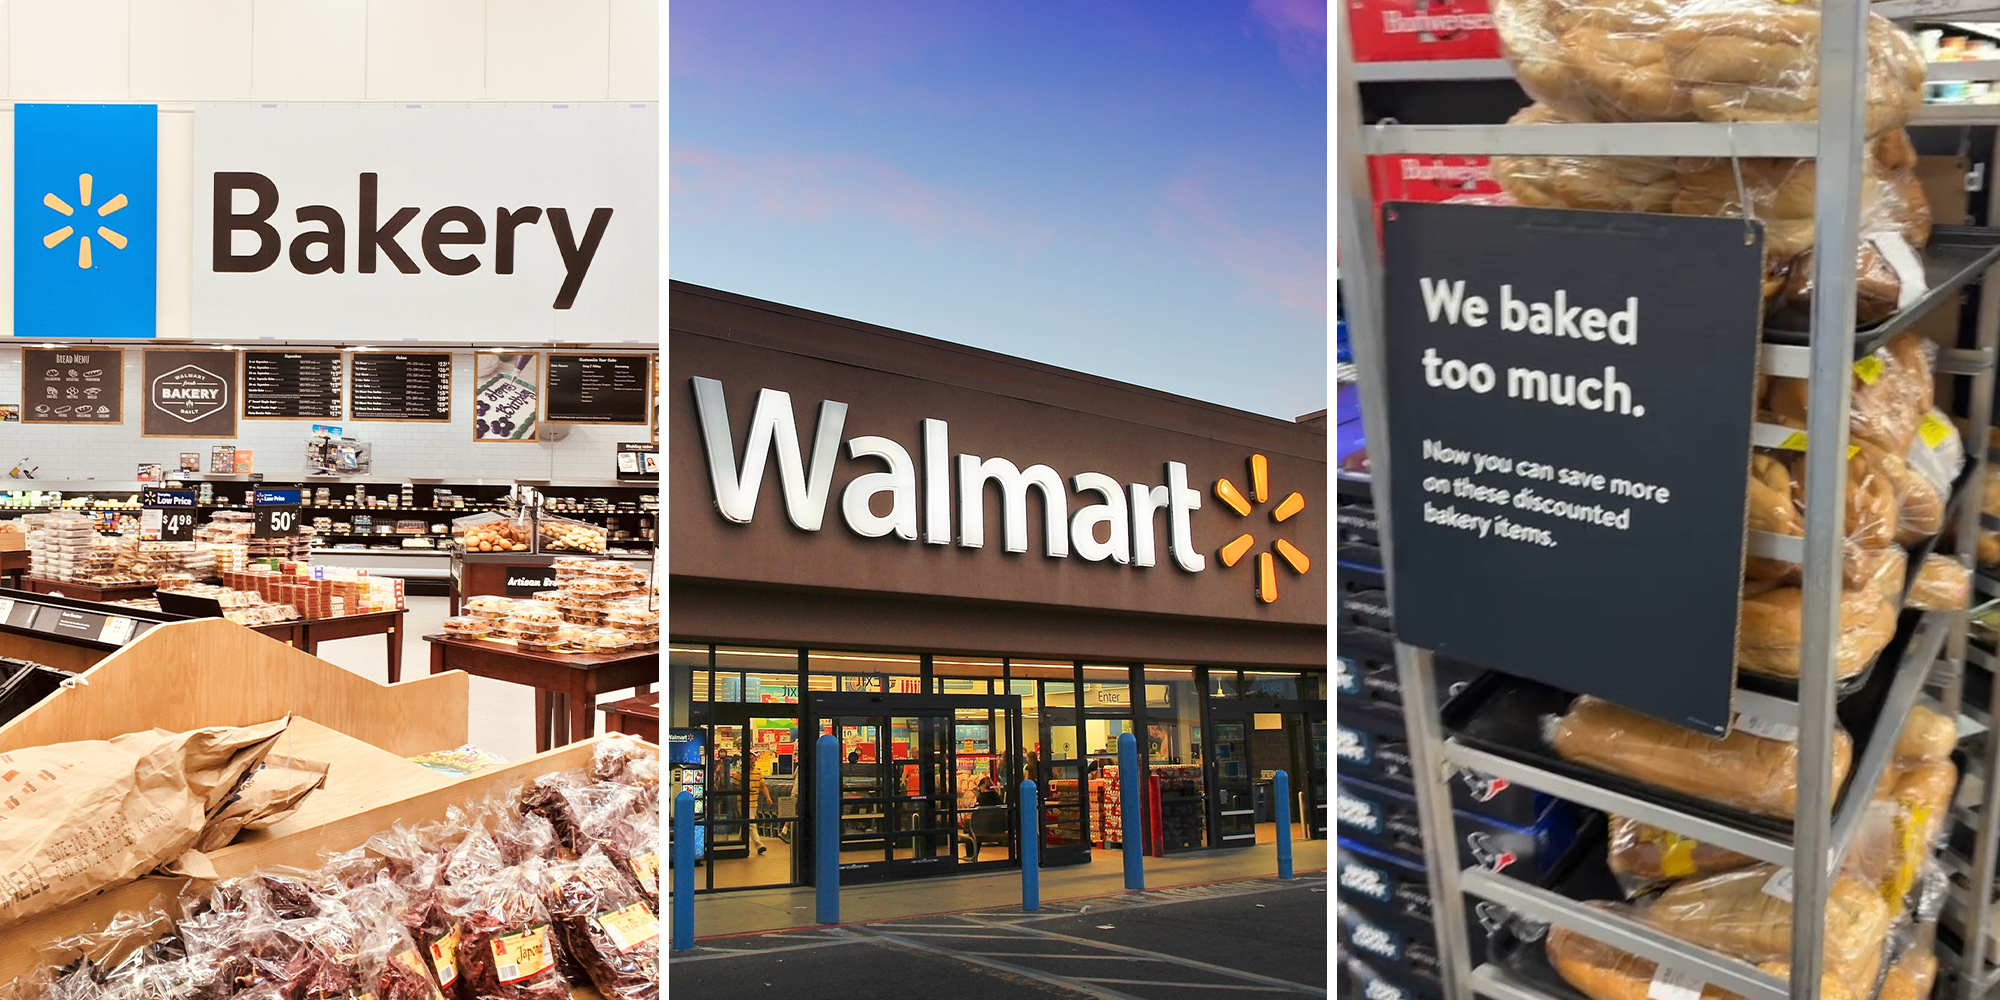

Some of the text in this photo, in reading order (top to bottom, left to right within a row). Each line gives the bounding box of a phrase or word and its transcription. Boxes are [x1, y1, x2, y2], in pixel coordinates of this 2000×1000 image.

[213, 171, 614, 310] Bakery
[1420, 277, 1639, 346] We baked
[74, 354, 90, 364] MENU
[174, 373, 206, 381] WALMART
[162, 388, 219, 399] BAKERY
[1422, 348, 1646, 418] too much.
[690, 375, 1206, 573] Walmart
[1423, 438, 1670, 504] Now you can save more
[157, 496, 192, 505] Low Price
[1423, 476, 1631, 531] on these discounted
[1423, 501, 1558, 547] bakery items.
[507, 577, 541, 587] Artisan
[1098, 690, 1120, 702] Enter
